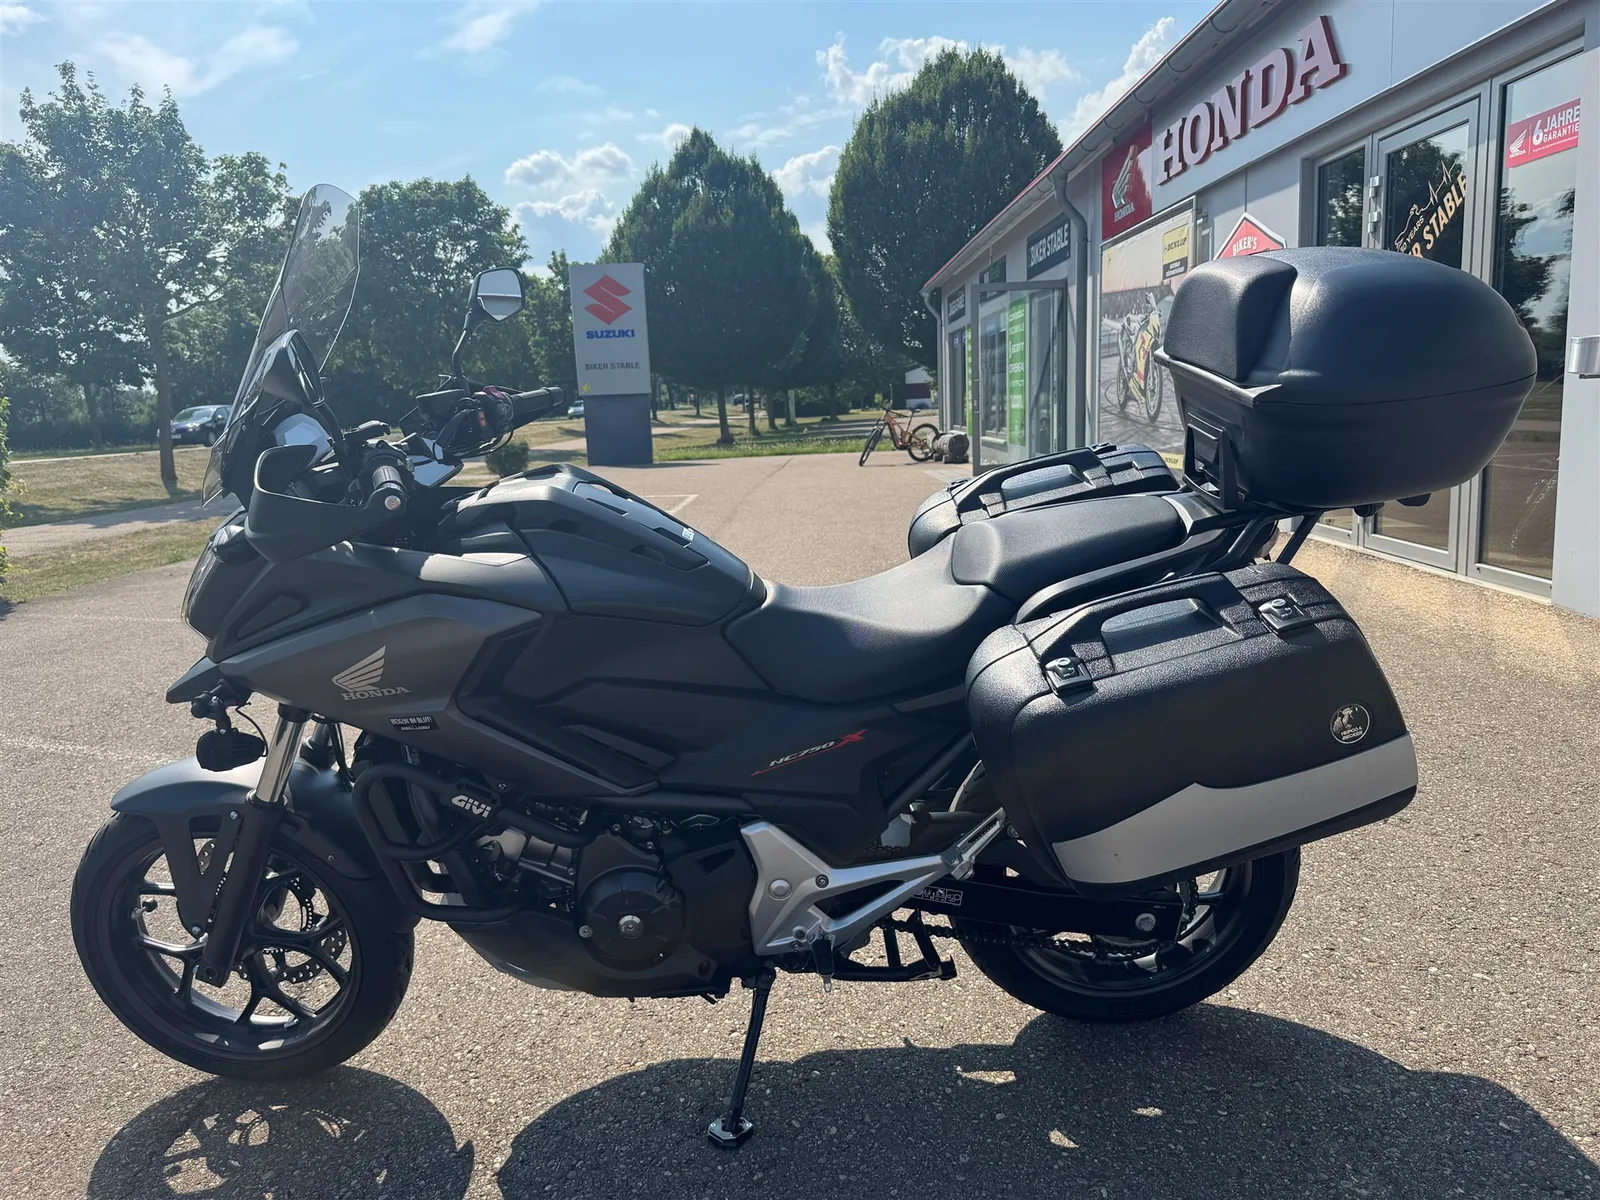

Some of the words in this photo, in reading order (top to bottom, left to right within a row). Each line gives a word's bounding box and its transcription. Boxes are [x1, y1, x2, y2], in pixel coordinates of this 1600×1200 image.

[1156, 15, 1347, 186] HONDA
[1532, 119, 1543, 146] 6
[1543, 105, 1580, 132] JAHRE
[1543, 122, 1579, 143] GARANTIE
[1423, 170, 1467, 250] STABLE
[1406, 215, 1424, 243] YEARS
[1030, 237, 1047, 267] BIKER
[1047, 223, 1069, 257] STABLE
[1166, 236, 1187, 252] DUNLOP
[1232, 235, 1258, 257] BIKER'S
[586, 329, 635, 340] SUZUKI
[585, 362, 609, 371] BIKER
[610, 361, 640, 370] STABLE
[341, 686, 411, 701] HONDA
[1341, 726, 1359, 736] HEPCO
[1342, 730, 1363, 741] BECKER
[451, 795, 492, 818] GIVI
